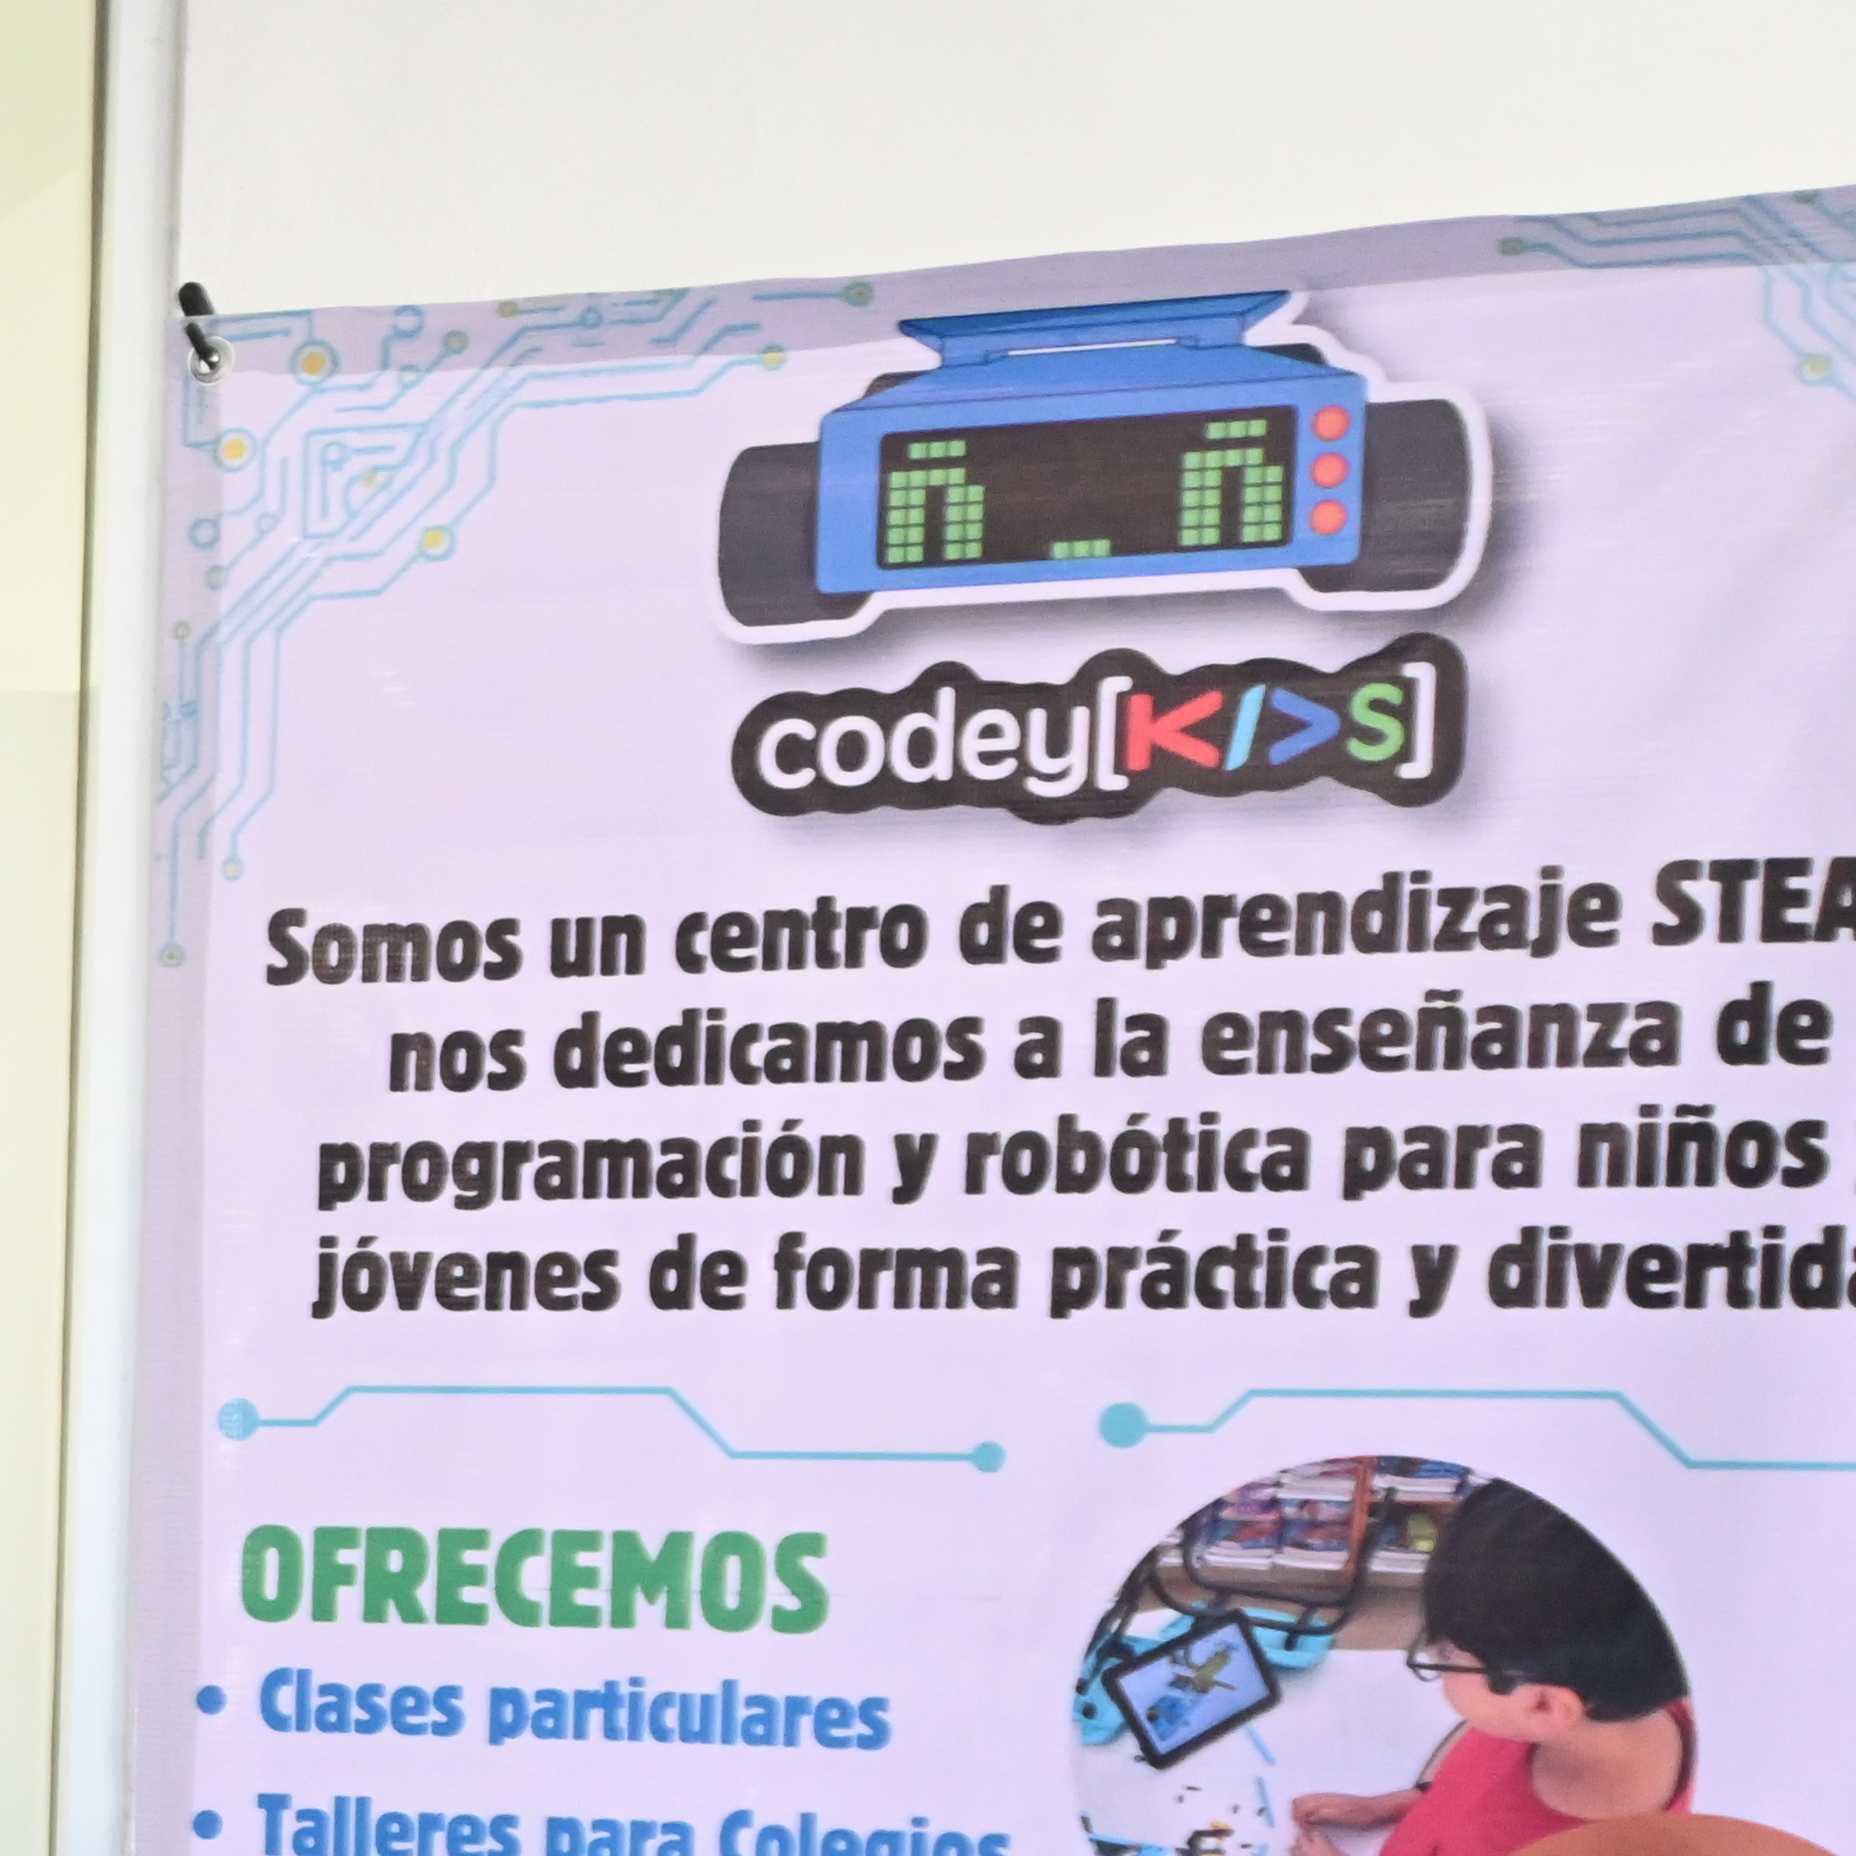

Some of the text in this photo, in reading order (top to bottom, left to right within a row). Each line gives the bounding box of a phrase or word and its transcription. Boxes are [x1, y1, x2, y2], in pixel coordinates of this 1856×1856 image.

[267, 908, 522, 986] Somos
[550, 914, 645, 978] un
[675, 896, 927, 974] centro
[959, 885, 1063, 965] de
[1092, 865, 1620, 970] aprendizaje
[390, 981, 1832, 1092] nos dedicamos a la enseñanza de
[318, 1119, 864, 1211] programación
[892, 1133, 937, 1205] y
[965, 1112, 1310, 1195] robótica
[1342, 1124, 1542, 1201] para
[1577, 1104, 1829, 1189] niños
[312, 1225, 1856, 1319] jóvenes de forma práctica y divertid
[242, 1525, 828, 1634] OFRECEMOS
[260, 1668, 891, 1750] Clases particulares
